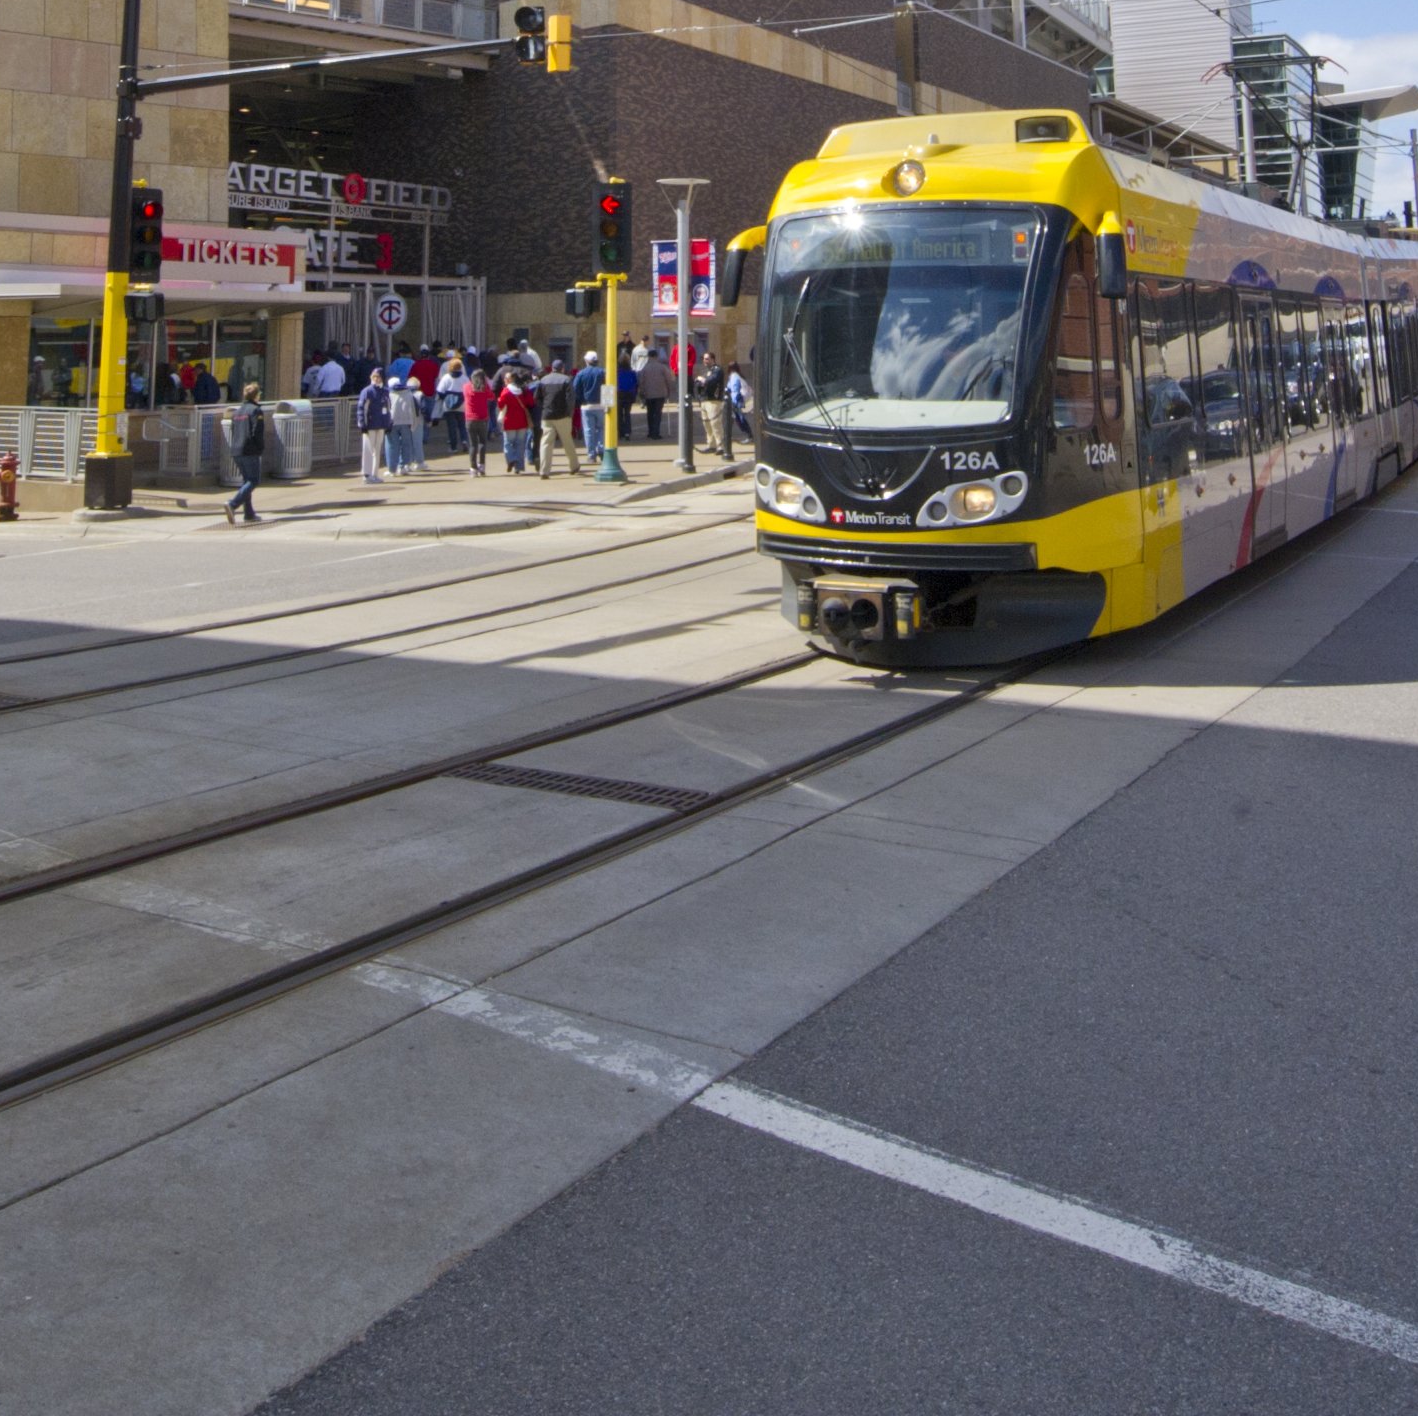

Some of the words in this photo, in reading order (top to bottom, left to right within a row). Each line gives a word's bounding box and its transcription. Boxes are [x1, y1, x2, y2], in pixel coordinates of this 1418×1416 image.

[228, 161, 342, 199] ARGET
[369, 178, 452, 211] FIELD
[228, 193, 252, 206] SURE
[254, 196, 290, 210] ISLAND
[349, 206, 372, 218] BANK
[178, 238, 279, 266] TICKETS
[275, 226, 360, 268] ATE
[376, 233, 394, 271] 3
[913, 237, 976, 258] America
[940, 451, 1000, 471] 126A
[1084, 443, 1116, 465] 126A
